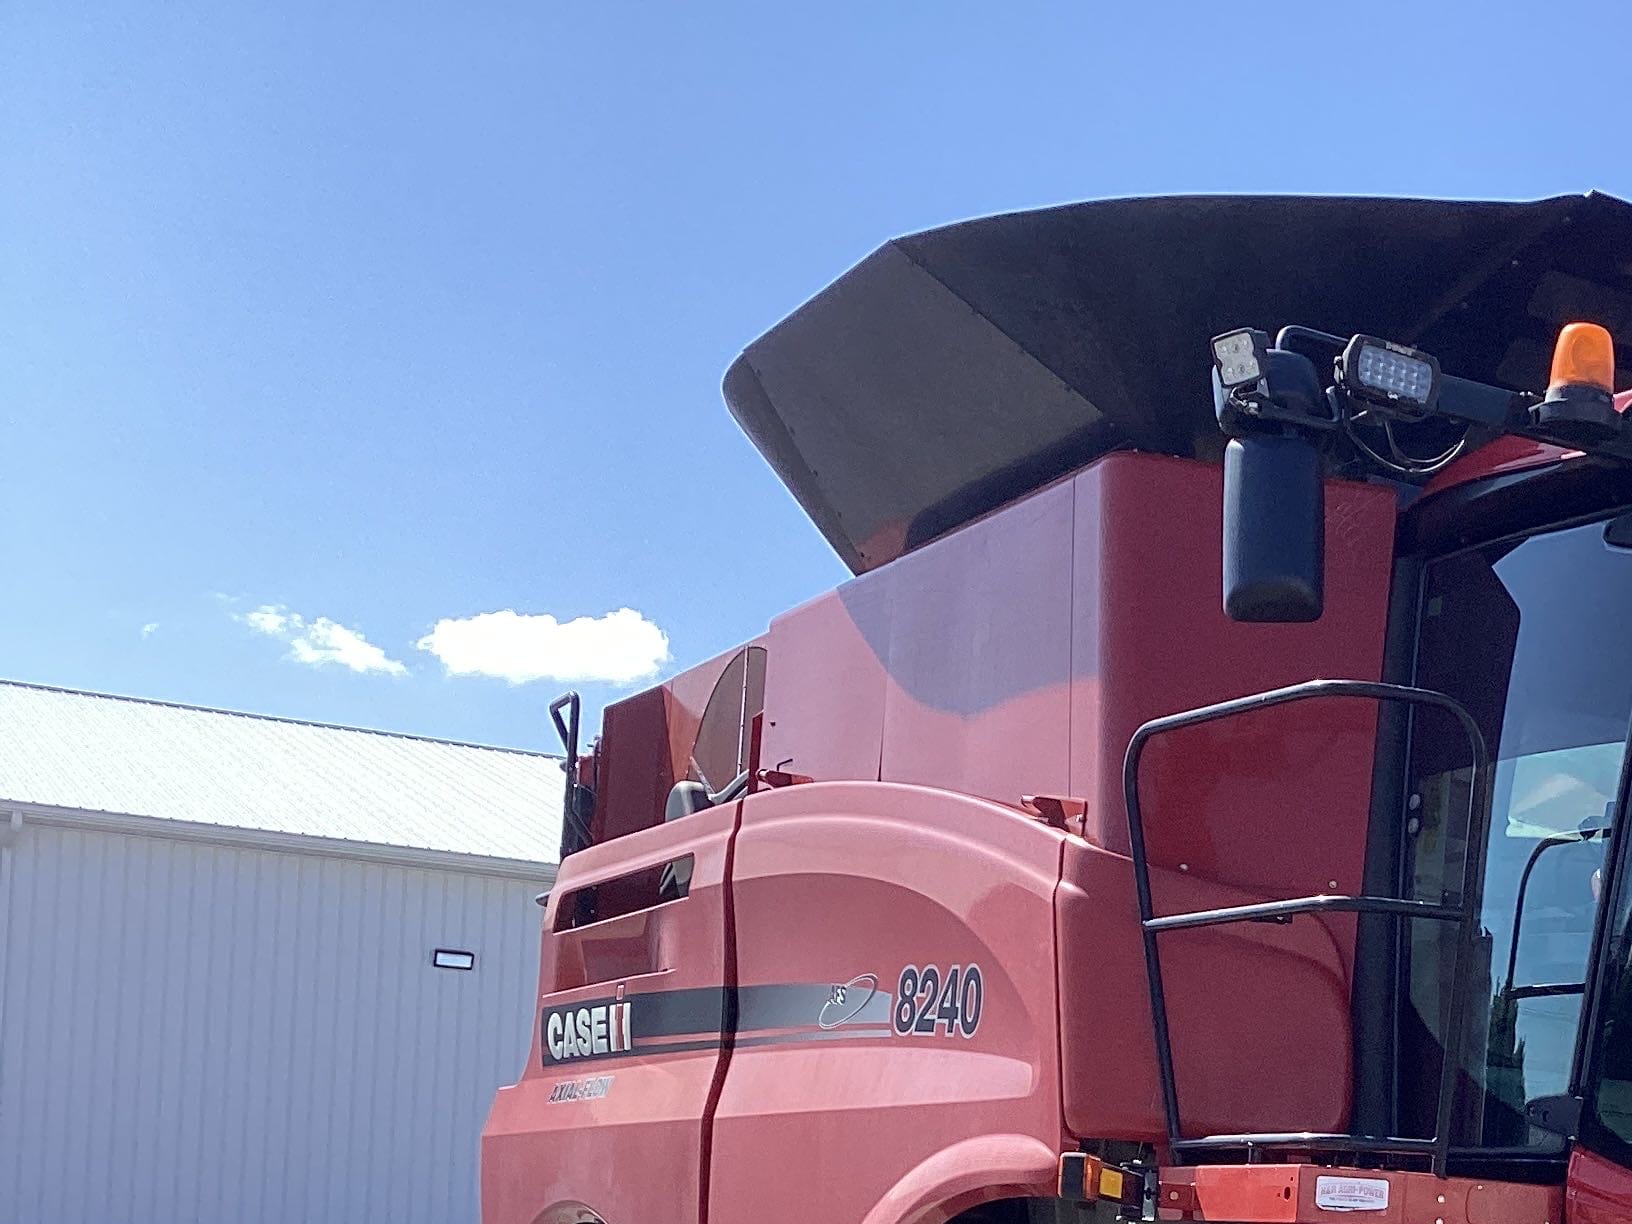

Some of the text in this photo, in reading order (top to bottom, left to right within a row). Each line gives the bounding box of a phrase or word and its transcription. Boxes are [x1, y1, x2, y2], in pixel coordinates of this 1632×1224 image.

[894, 963, 983, 1039] 8240
[547, 1007, 609, 1061] CASE
[548, 1076, 615, 1104] AXIAL-FLOW
